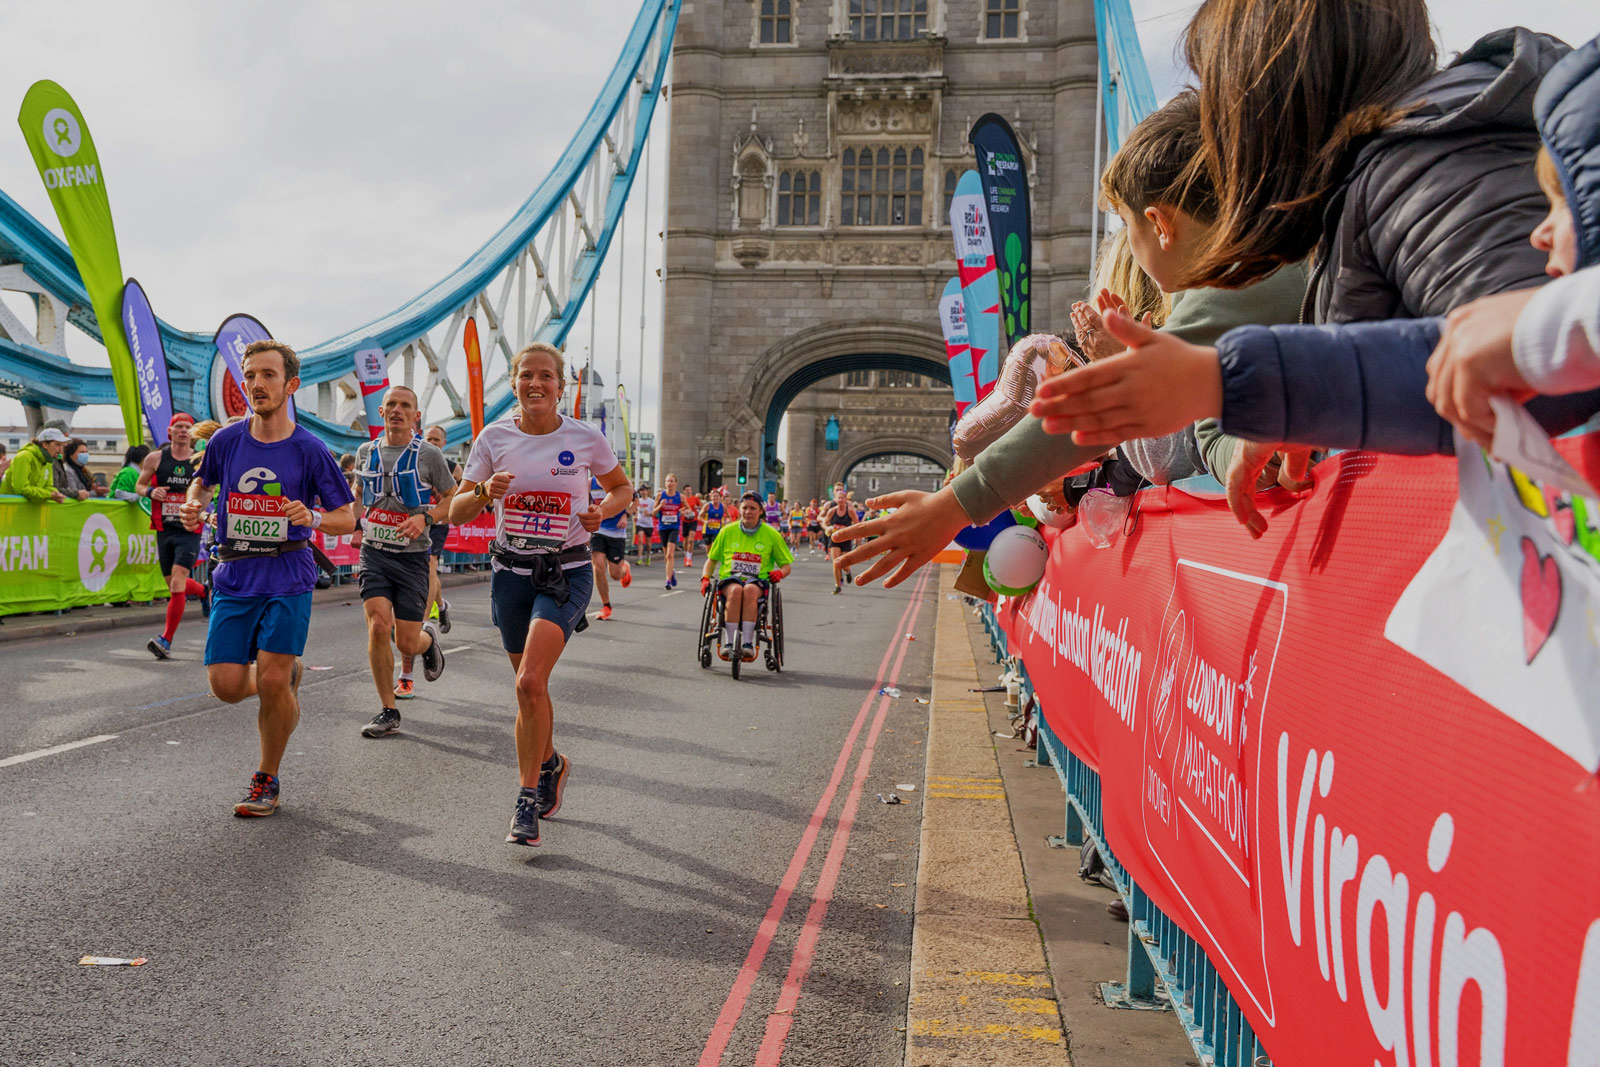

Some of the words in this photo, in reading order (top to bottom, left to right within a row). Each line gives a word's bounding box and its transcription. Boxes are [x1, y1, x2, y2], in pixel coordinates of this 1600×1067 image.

[44, 164, 98, 189] OXFAM
[166, 476, 191, 485] ARMY
[231, 497, 285, 512] MONEY
[515, 497, 559, 515] Susan
[234, 519, 280, 537] 46022
[522, 515, 551, 533] 714
[0, 535, 49, 572] XFAM
[126, 534, 160, 565] OXF
[1058, 590, 1090, 677] London
[1090, 603, 1142, 732] Marathon
[1187, 655, 1236, 745] LONDON
[1181, 726, 1249, 858] MARATHON
[1277, 731, 1507, 1067] Virgin
